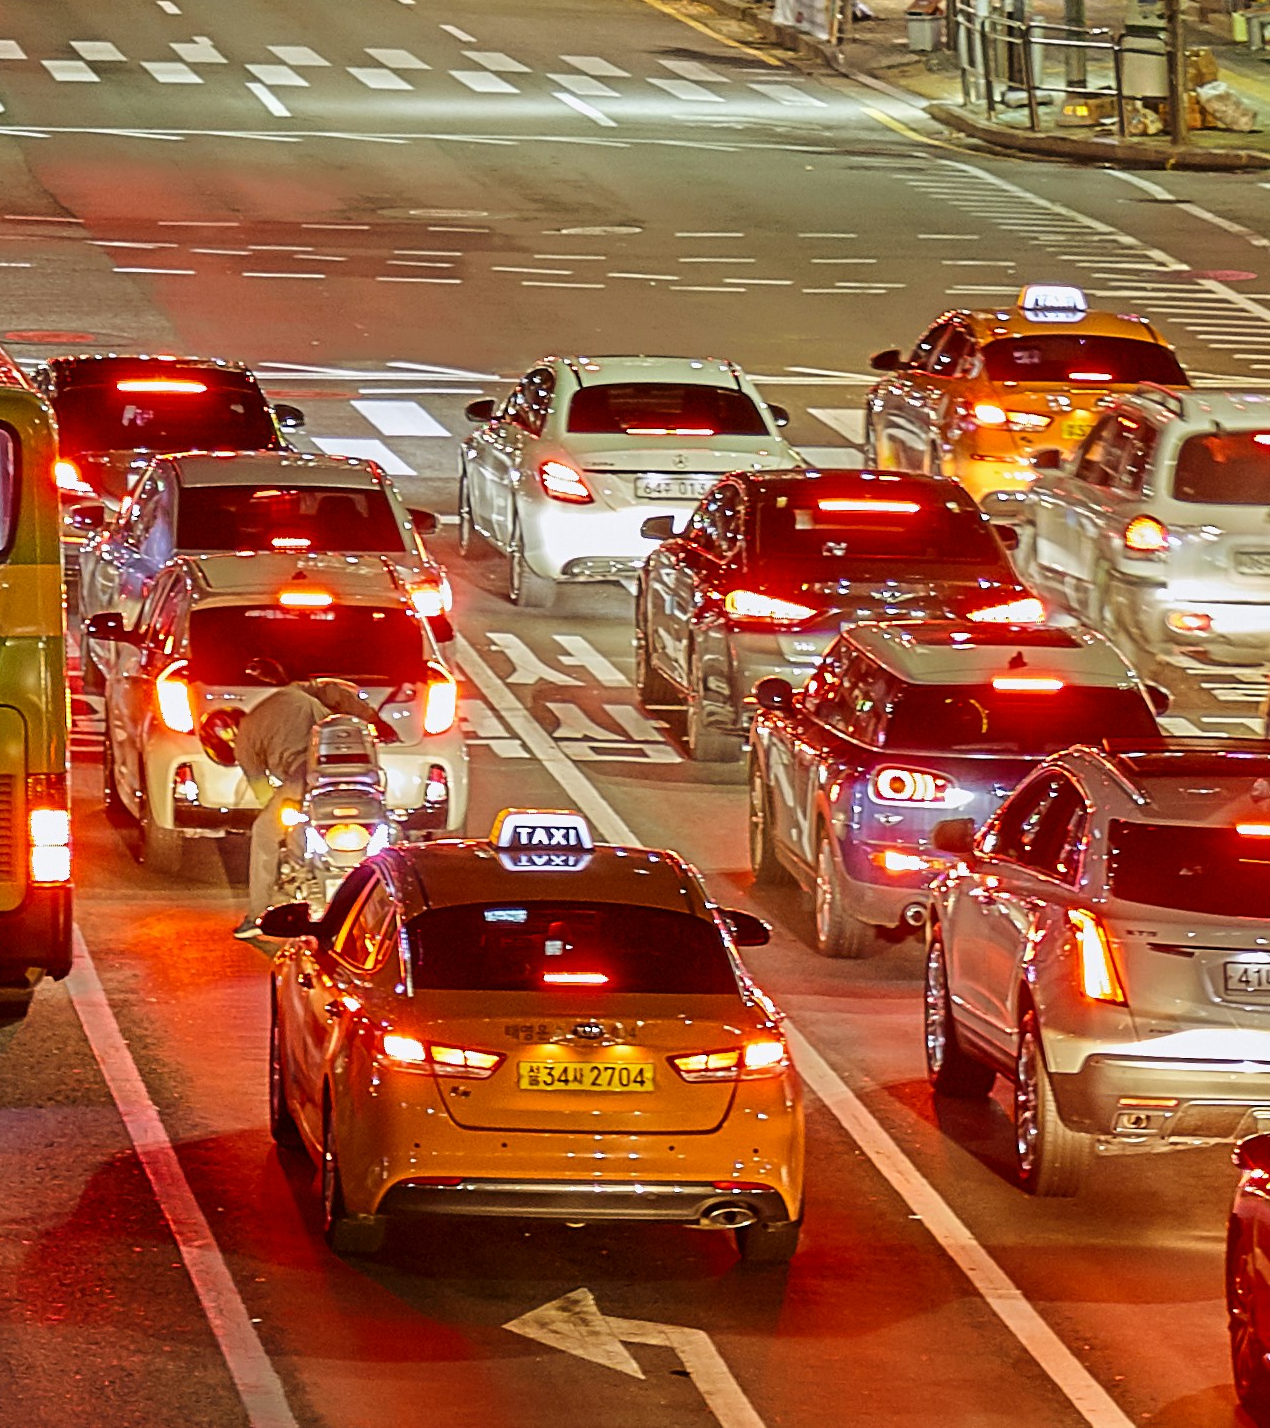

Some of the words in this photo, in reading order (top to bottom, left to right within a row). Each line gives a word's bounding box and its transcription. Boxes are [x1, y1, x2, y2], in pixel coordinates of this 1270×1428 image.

[678, 482, 708, 496] 013
[515, 827, 578, 846] TAXI
[589, 1065, 647, 1088] 2704
